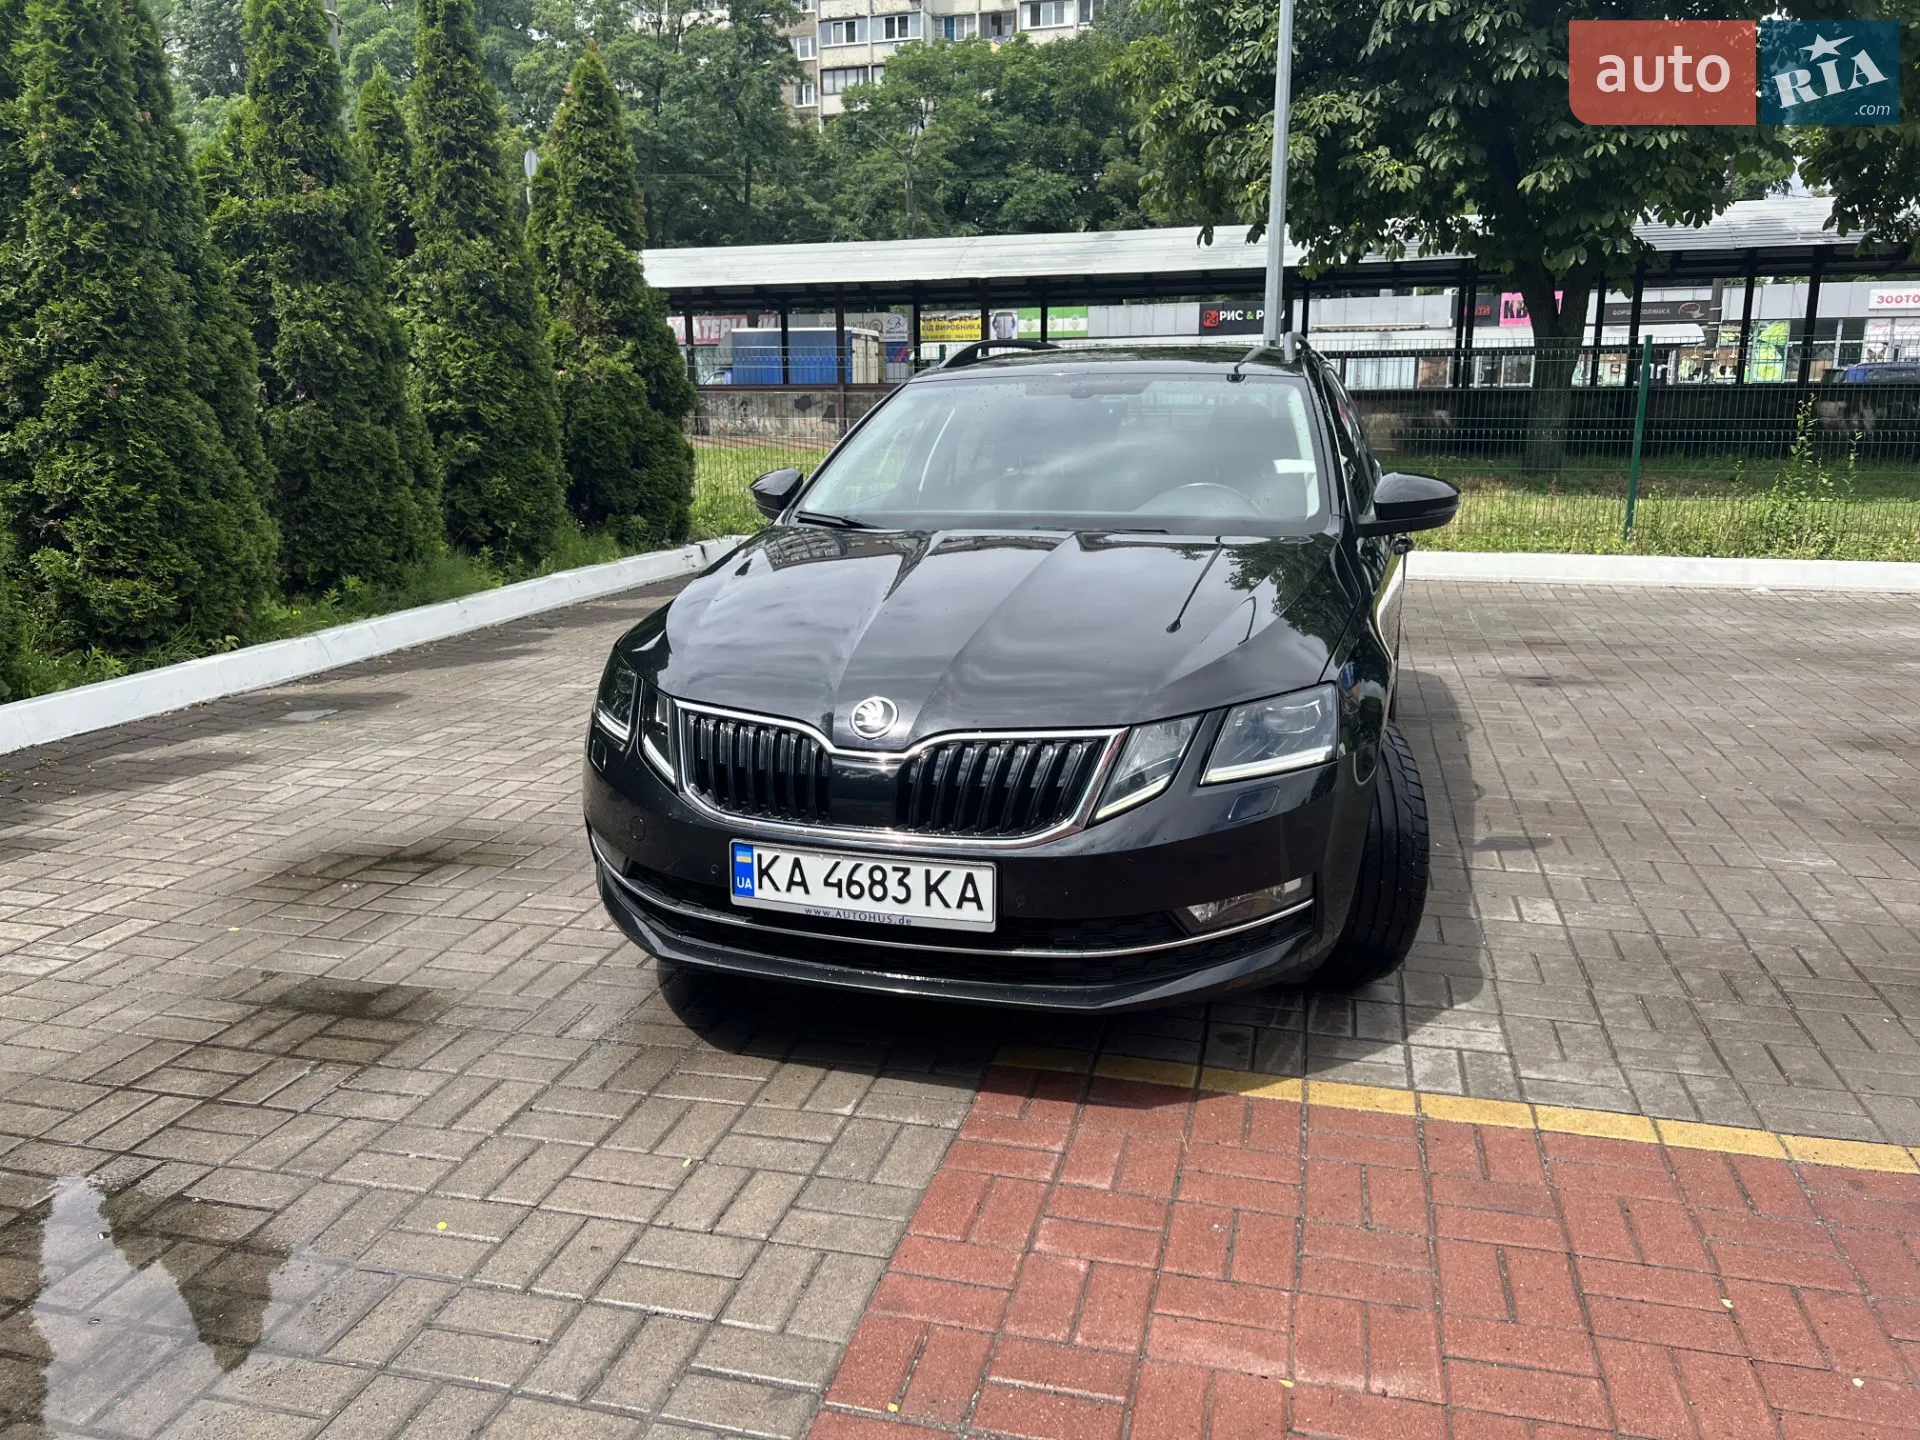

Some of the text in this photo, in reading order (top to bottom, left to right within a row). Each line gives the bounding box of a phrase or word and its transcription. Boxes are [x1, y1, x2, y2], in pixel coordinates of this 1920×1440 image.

[1219, 310, 1244, 321] РИС
[1246, 310, 1254, 320] &
[736, 876, 752, 890] UA
[756, 852, 985, 912] KA 4683 KA
[804, 907, 913, 925] www.AUTOHUS.de
